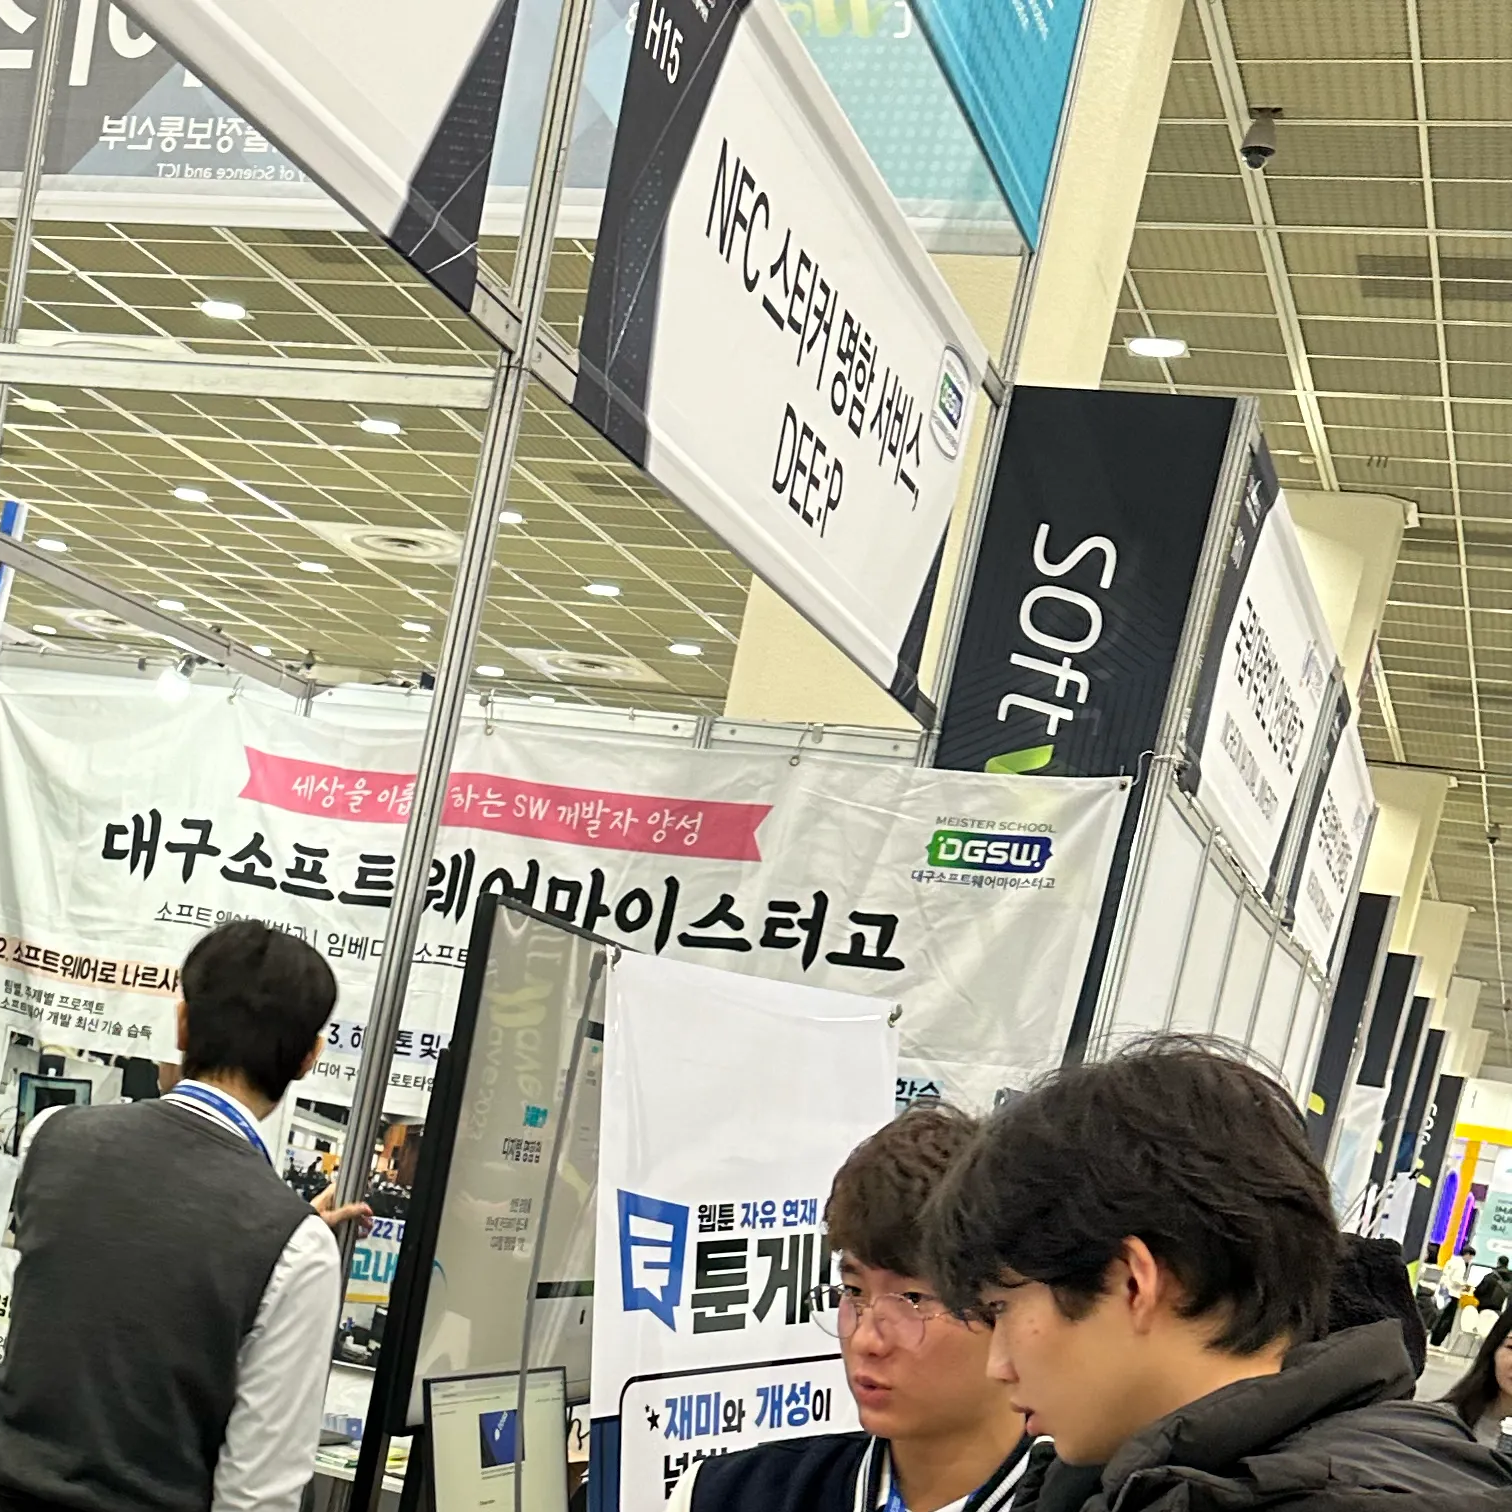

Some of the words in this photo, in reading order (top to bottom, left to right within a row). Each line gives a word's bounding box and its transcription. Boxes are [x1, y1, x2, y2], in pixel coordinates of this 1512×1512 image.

[645, 0, 684, 84] H15
[705, 137, 770, 293] NFC
[762, 228, 839, 391] 스티커
[831, 309, 879, 438] 명함
[870, 366, 924, 512] 서비스
[291, 775, 373, 814] 세상을
[451, 784, 507, 818] 하는
[513, 795, 550, 822] SW
[557, 801, 639, 839] 개발자
[648, 809, 705, 847] 양성
[935, 815, 998, 831] MEISTER
[999, 820, 1058, 835] SCHOOL
[46, 1010, 73, 1028] 개발
[56, 995, 106, 1016] 프로젝트
[697, 1203, 735, 1233] 웹툰
[739, 1198, 777, 1230] 자유
[782, 1197, 818, 1228] 연재
[663, 1391, 746, 1441] 재미와
[755, 1381, 832, 1429] 개성이
